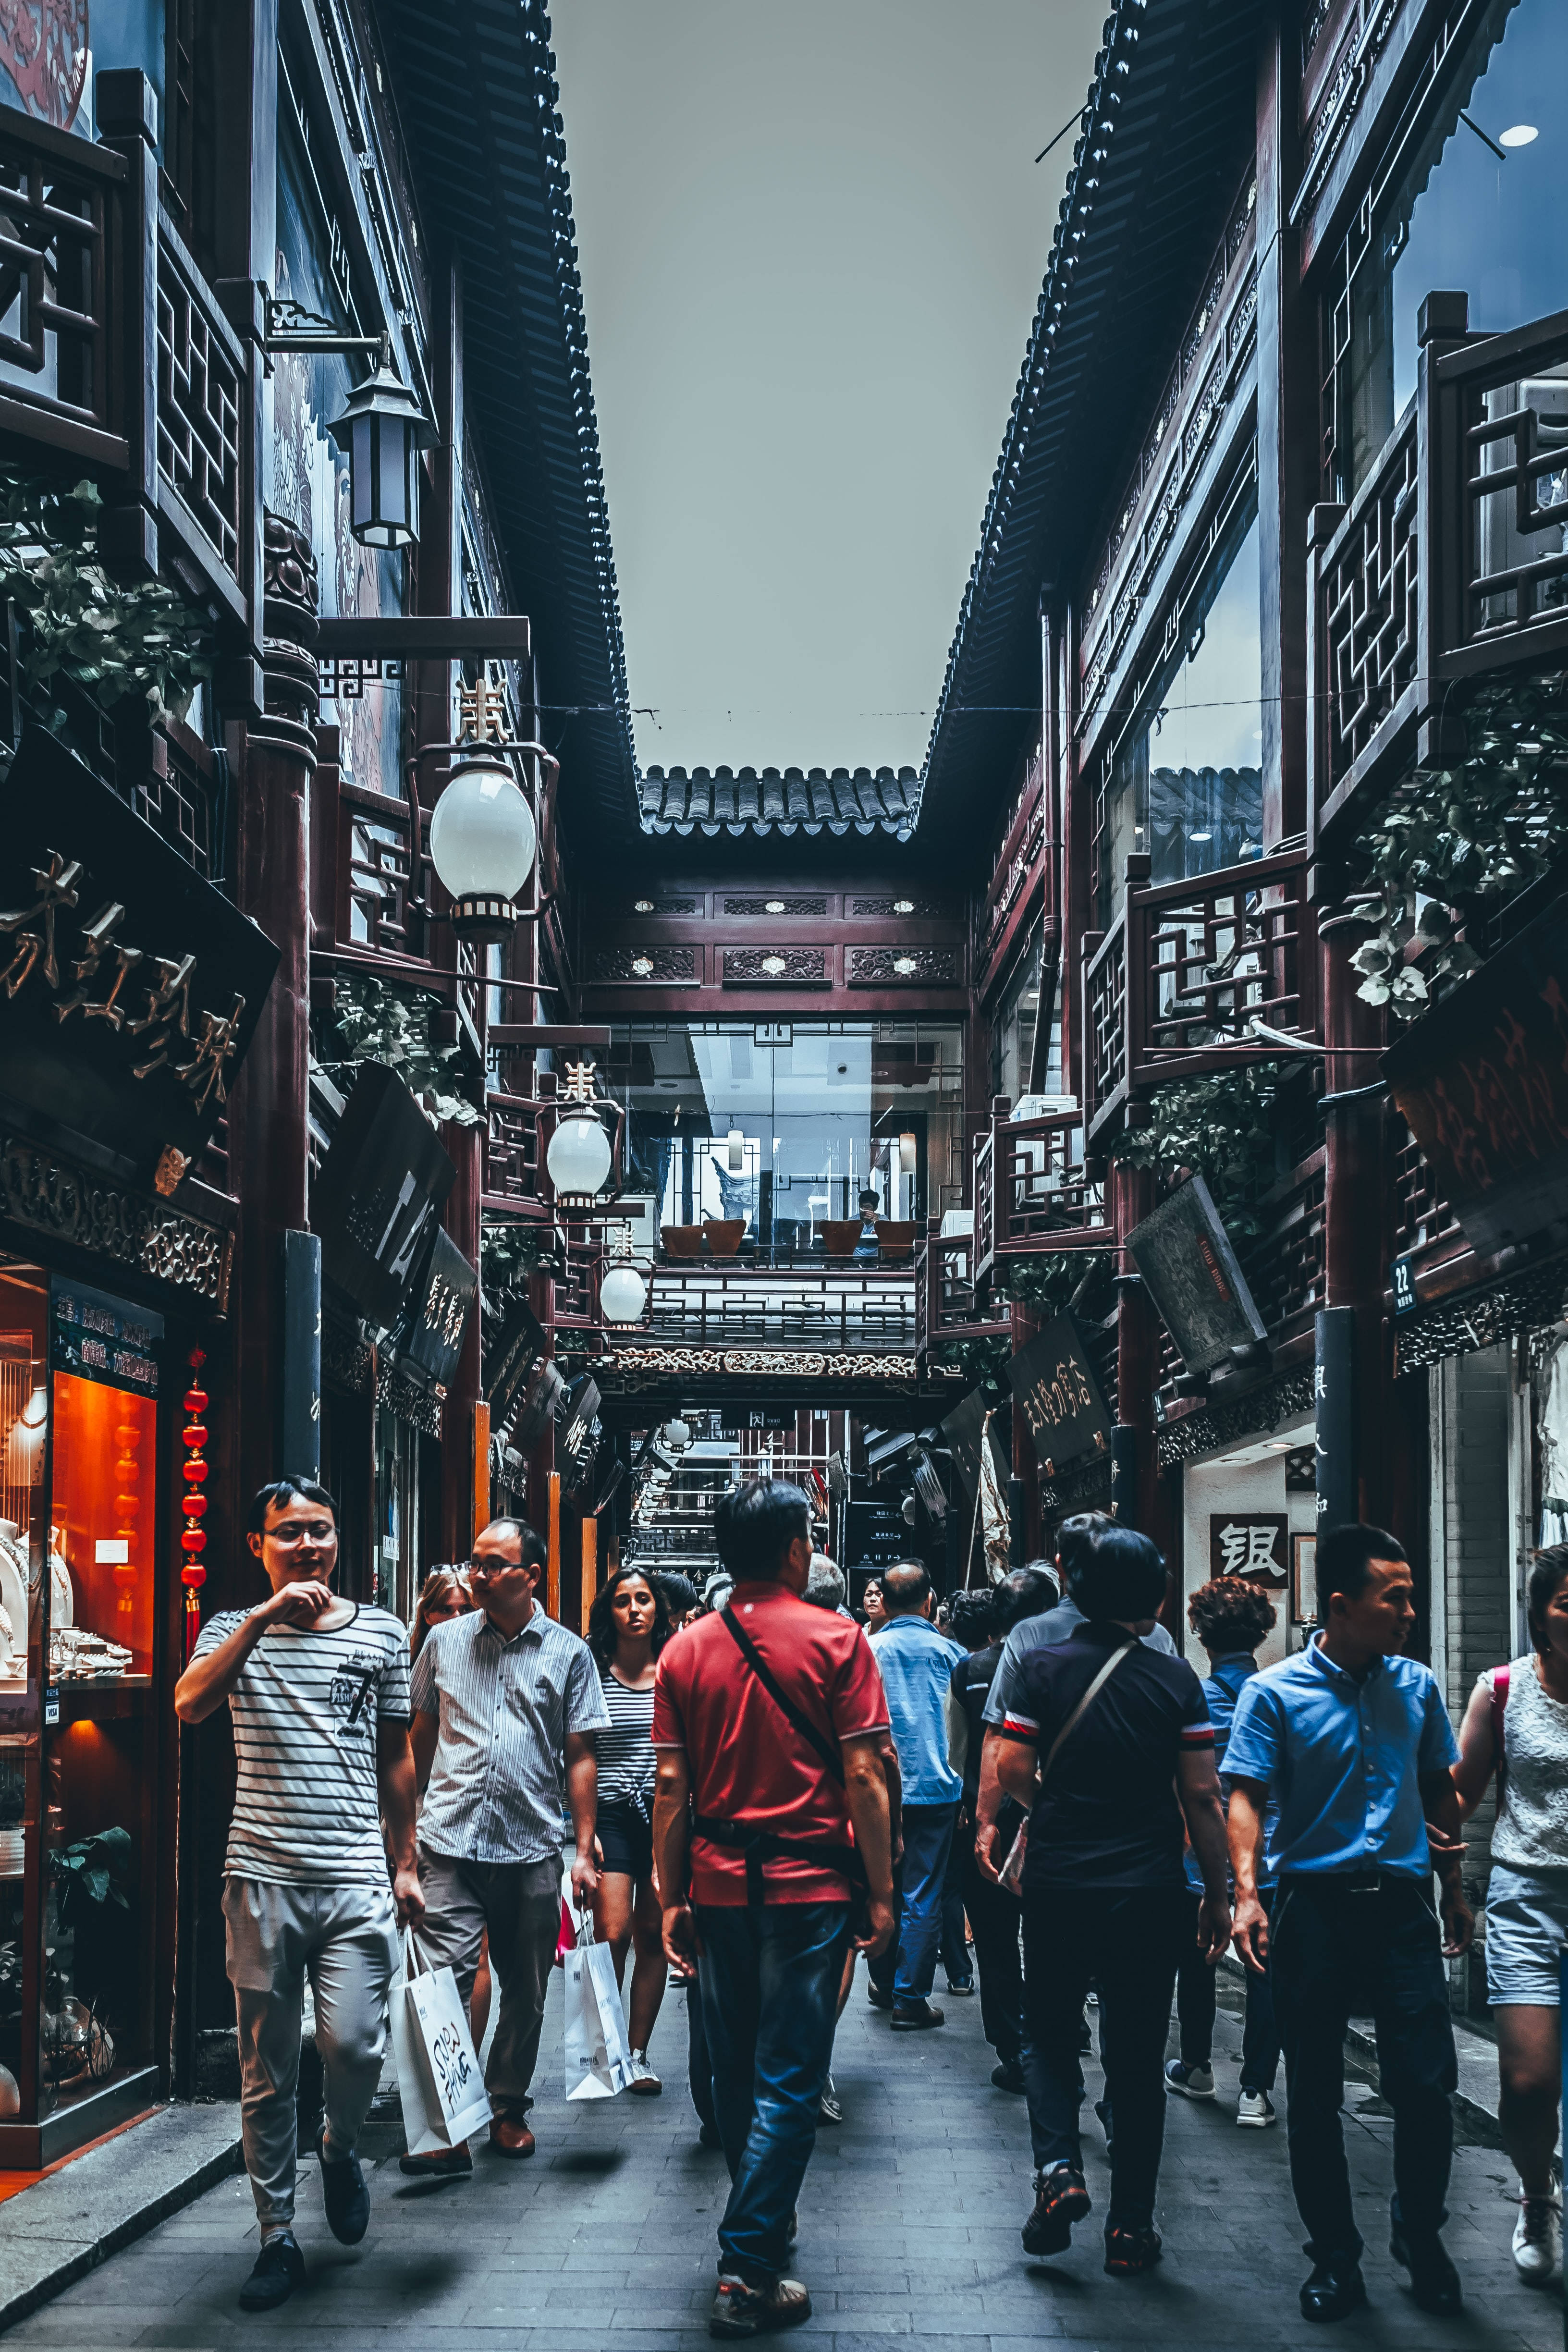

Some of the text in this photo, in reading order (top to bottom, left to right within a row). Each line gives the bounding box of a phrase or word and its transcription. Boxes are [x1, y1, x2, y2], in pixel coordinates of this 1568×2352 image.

[1396, 1265, 1409, 1293] 22
[1219, 1523, 1286, 1577] 银
[48, 1708, 58, 1717] VISA
